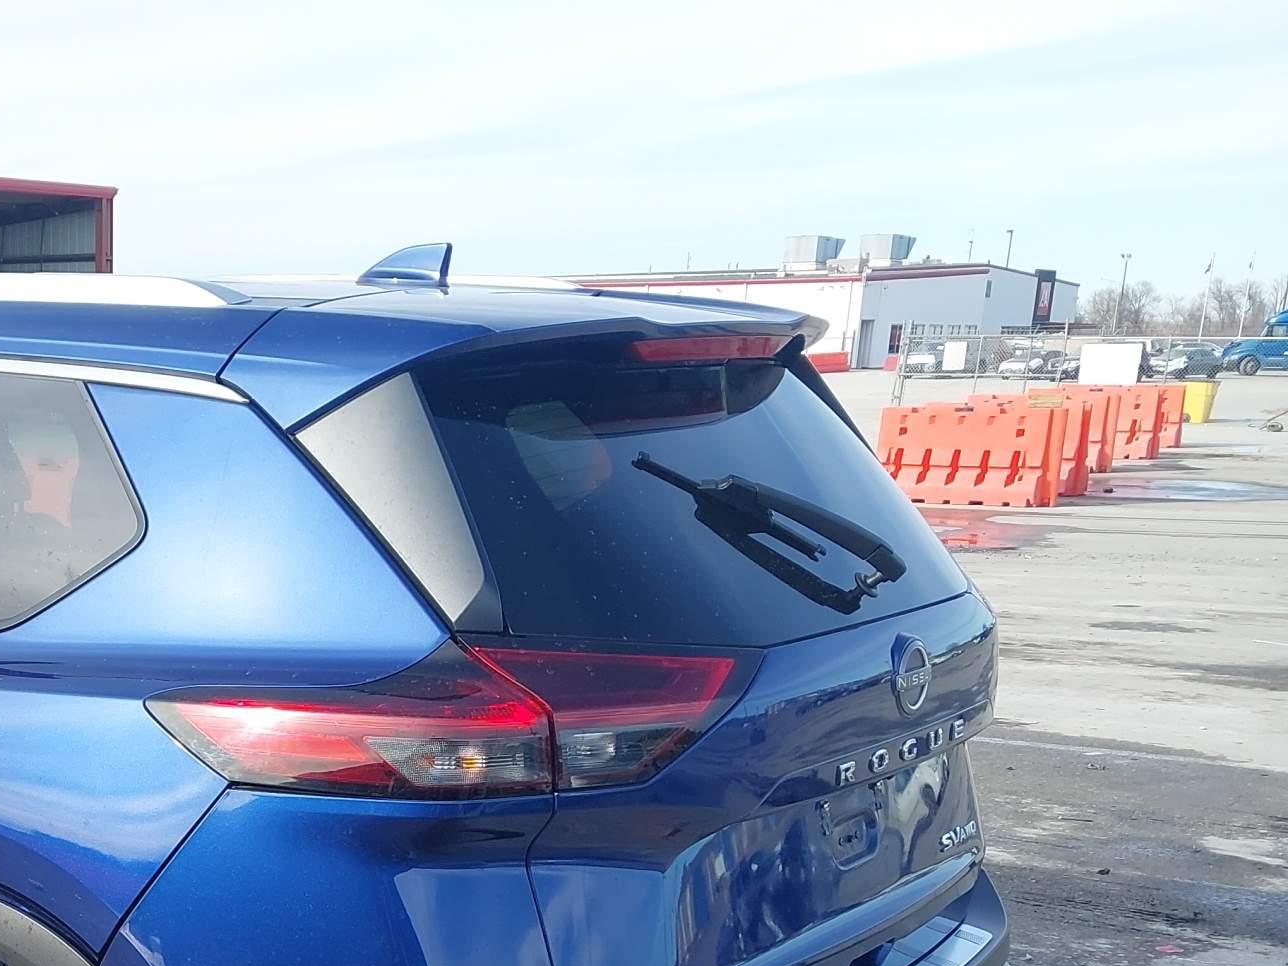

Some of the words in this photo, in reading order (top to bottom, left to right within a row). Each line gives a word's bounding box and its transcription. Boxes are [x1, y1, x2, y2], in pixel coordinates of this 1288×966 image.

[898, 671, 930, 689] NISS
[836, 718, 965, 787] ROGUE
[941, 825, 960, 850] SV
